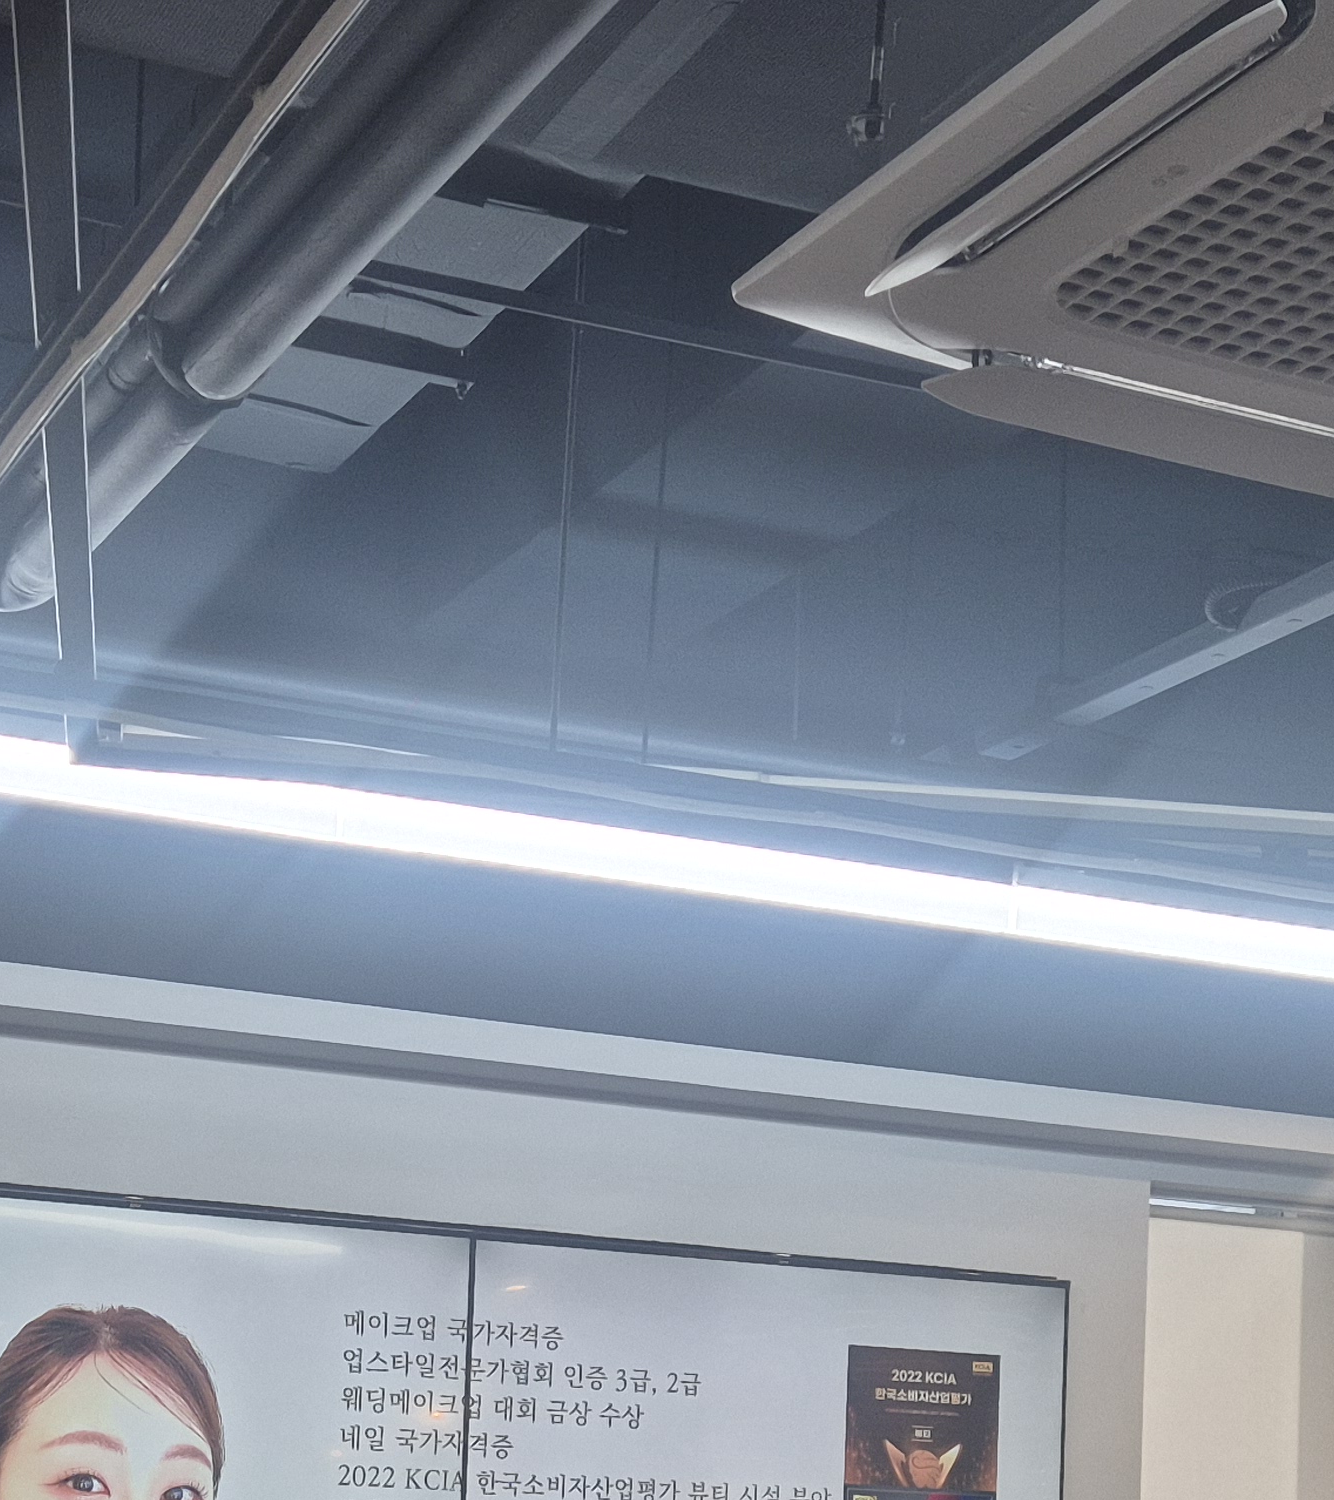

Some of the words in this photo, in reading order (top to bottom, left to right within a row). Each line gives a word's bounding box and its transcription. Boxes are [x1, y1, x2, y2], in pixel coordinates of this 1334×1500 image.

[343, 1309, 436, 1342] 메이크업
[447, 1317, 564, 1351] 국가자격증
[342, 1347, 554, 1388] 업스타일전문가협회
[564, 1363, 608, 1391] 인증
[615, 1368, 658, 1396] 3급,
[666, 1371, 702, 1397] 2급
[891, 1369, 923, 1383] 2022
[925, 1372, 957, 1385] KCIA
[341, 1385, 482, 1420] 웨딩메이크업
[494, 1395, 537, 1424] 대회
[546, 1400, 592, 1427] 금상
[598, 1402, 645, 1430] 수상
[874, 1387, 973, 1406] 한국소비자산업평가
[340, 1424, 385, 1452] 네일
[395, 1428, 514, 1460] 국가자격증
[338, 1463, 396, 1489] 2022
[404, 1468, 464, 1492] KCIA
